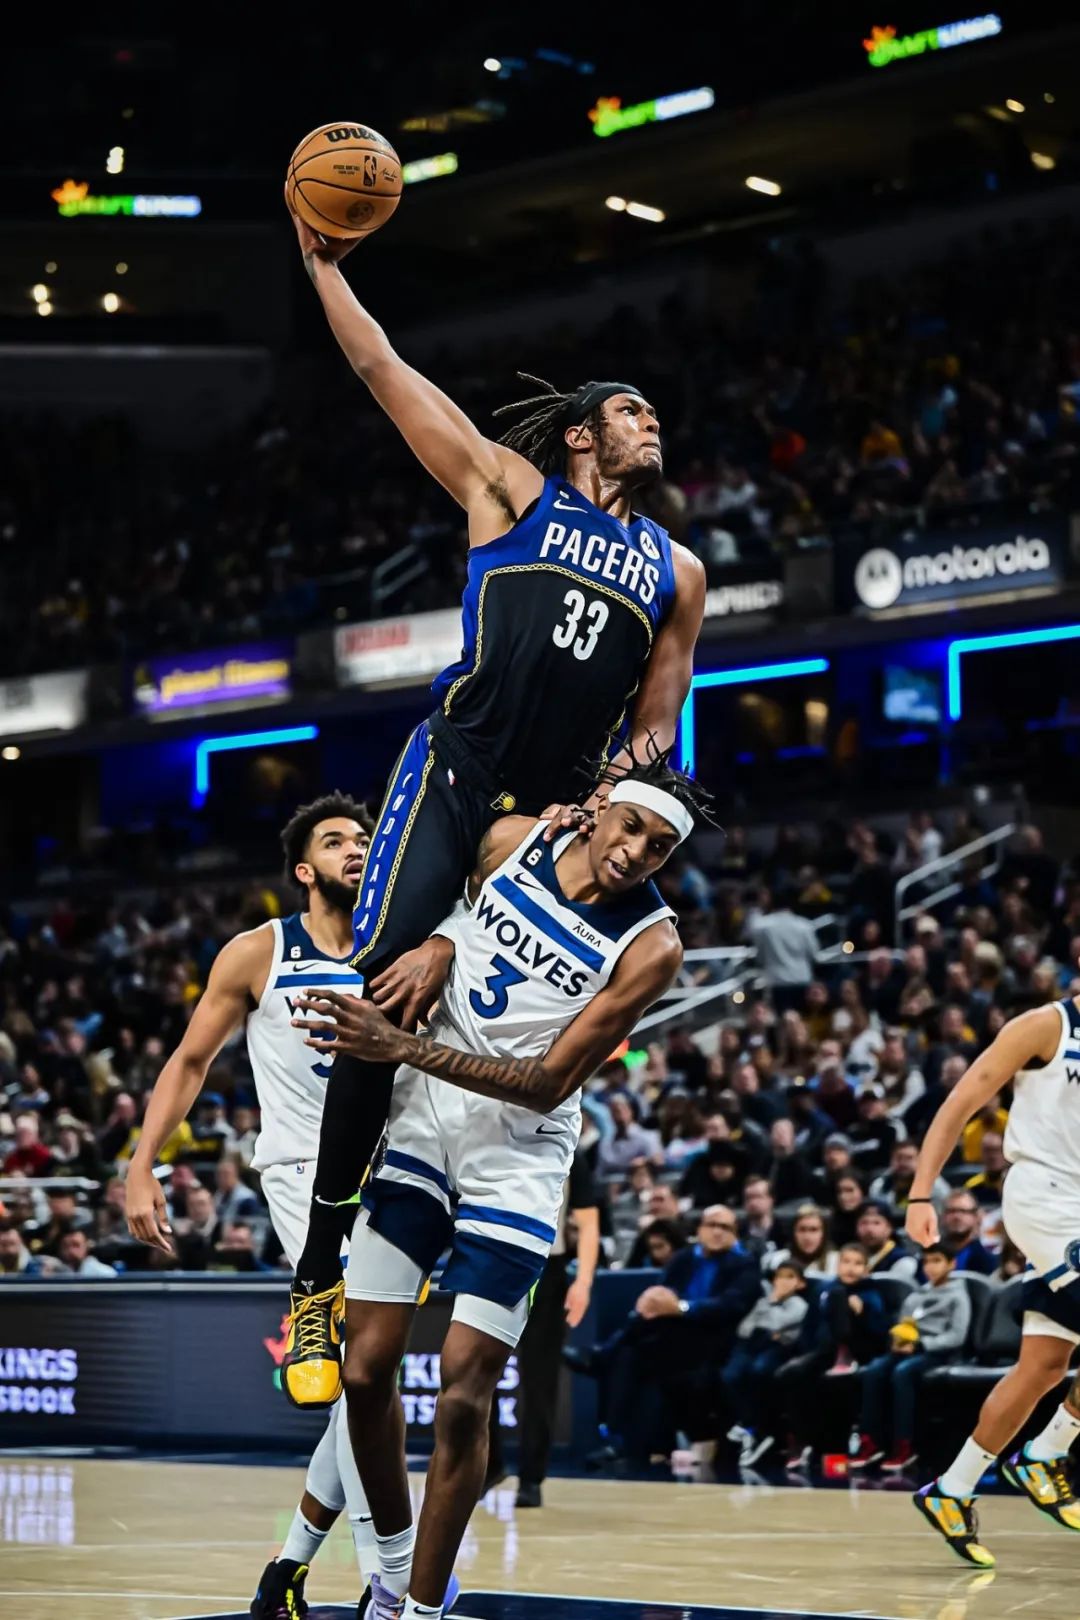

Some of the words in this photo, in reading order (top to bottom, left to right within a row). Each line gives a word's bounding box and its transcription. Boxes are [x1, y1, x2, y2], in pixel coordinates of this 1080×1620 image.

[539, 522, 659, 604] PACERS
[903, 534, 1051, 588] motorola
[552, 589, 609, 661] 33
[356, 772, 413, 931] INDIANA
[526, 847, 543, 866] 6
[476, 894, 589, 997] WOLVES
[468, 953, 529, 1020] 3
